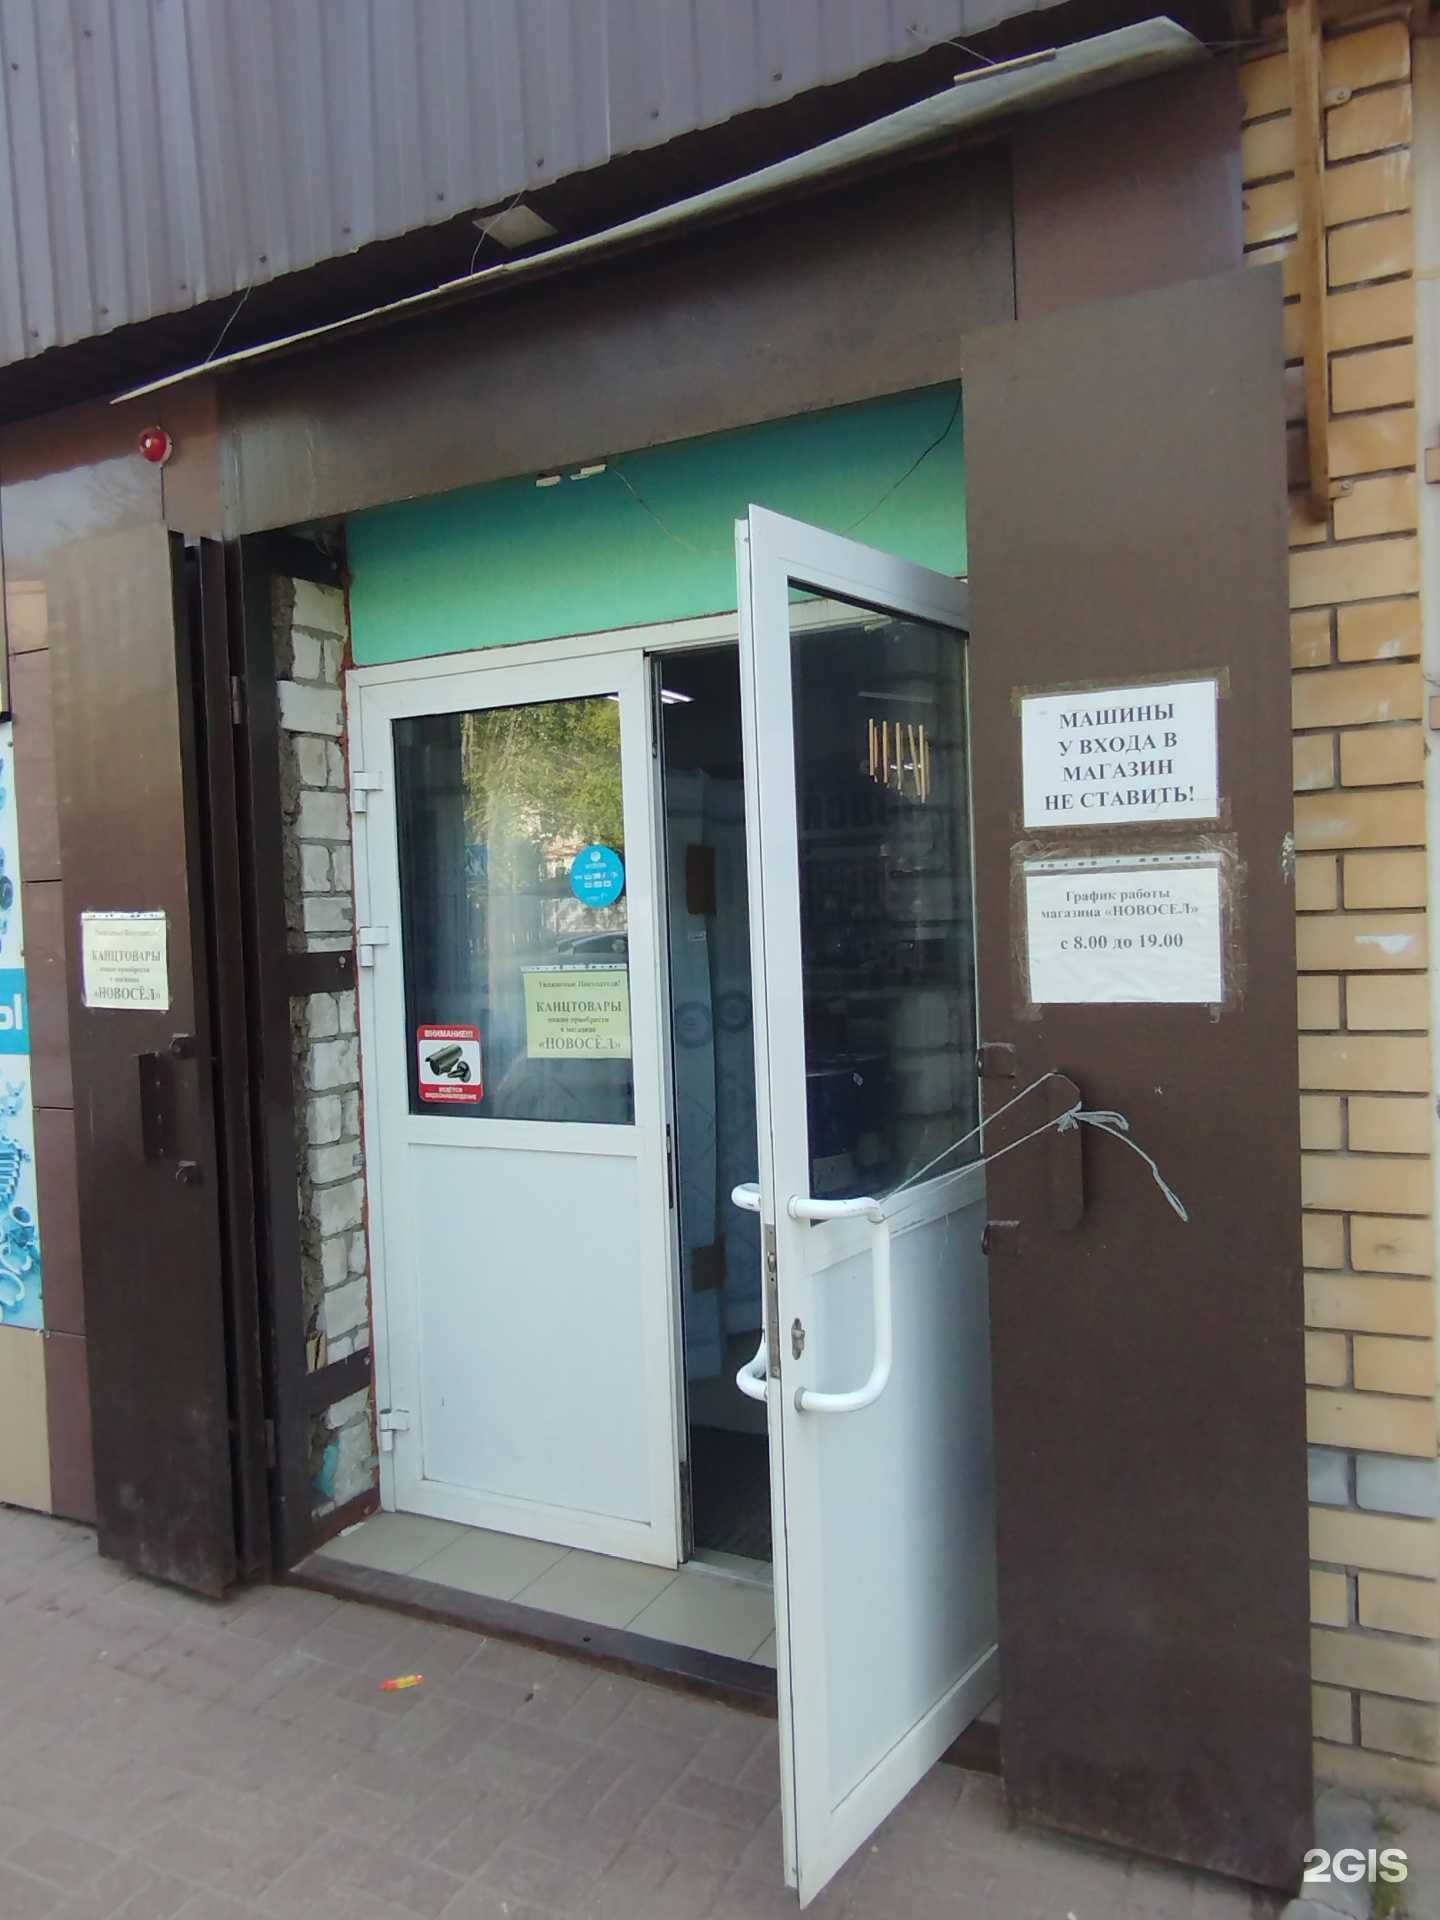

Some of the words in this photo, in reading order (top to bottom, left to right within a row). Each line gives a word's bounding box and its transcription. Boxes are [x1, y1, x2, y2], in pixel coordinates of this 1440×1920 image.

[1058, 703, 1175, 729] МАШИНЫ
[1058, 740, 1073, 757] У
[1080, 733, 1157, 755] ВХОДА
[1164, 732, 1178, 748] В
[1062, 759, 1174, 782] МАГАЗИН
[1045, 794, 1074, 811] НЕ
[1080, 785, 1195, 808] СТАВИТЬ!
[1066, 890, 1117, 904] График
[1120, 888, 1171, 902] работы
[1041, 908, 1101, 919] магазина
[1060, 939, 1069, 950] с
[1073, 935, 1108, 950] 8.00
[1112, 937, 1133, 949] до
[1139, 933, 1184, 949] 19.00
[91, 950, 161, 962] КАНЦТОВАРЫ
[536, 1000, 623, 1013] КАНЦТОВАРЫ
